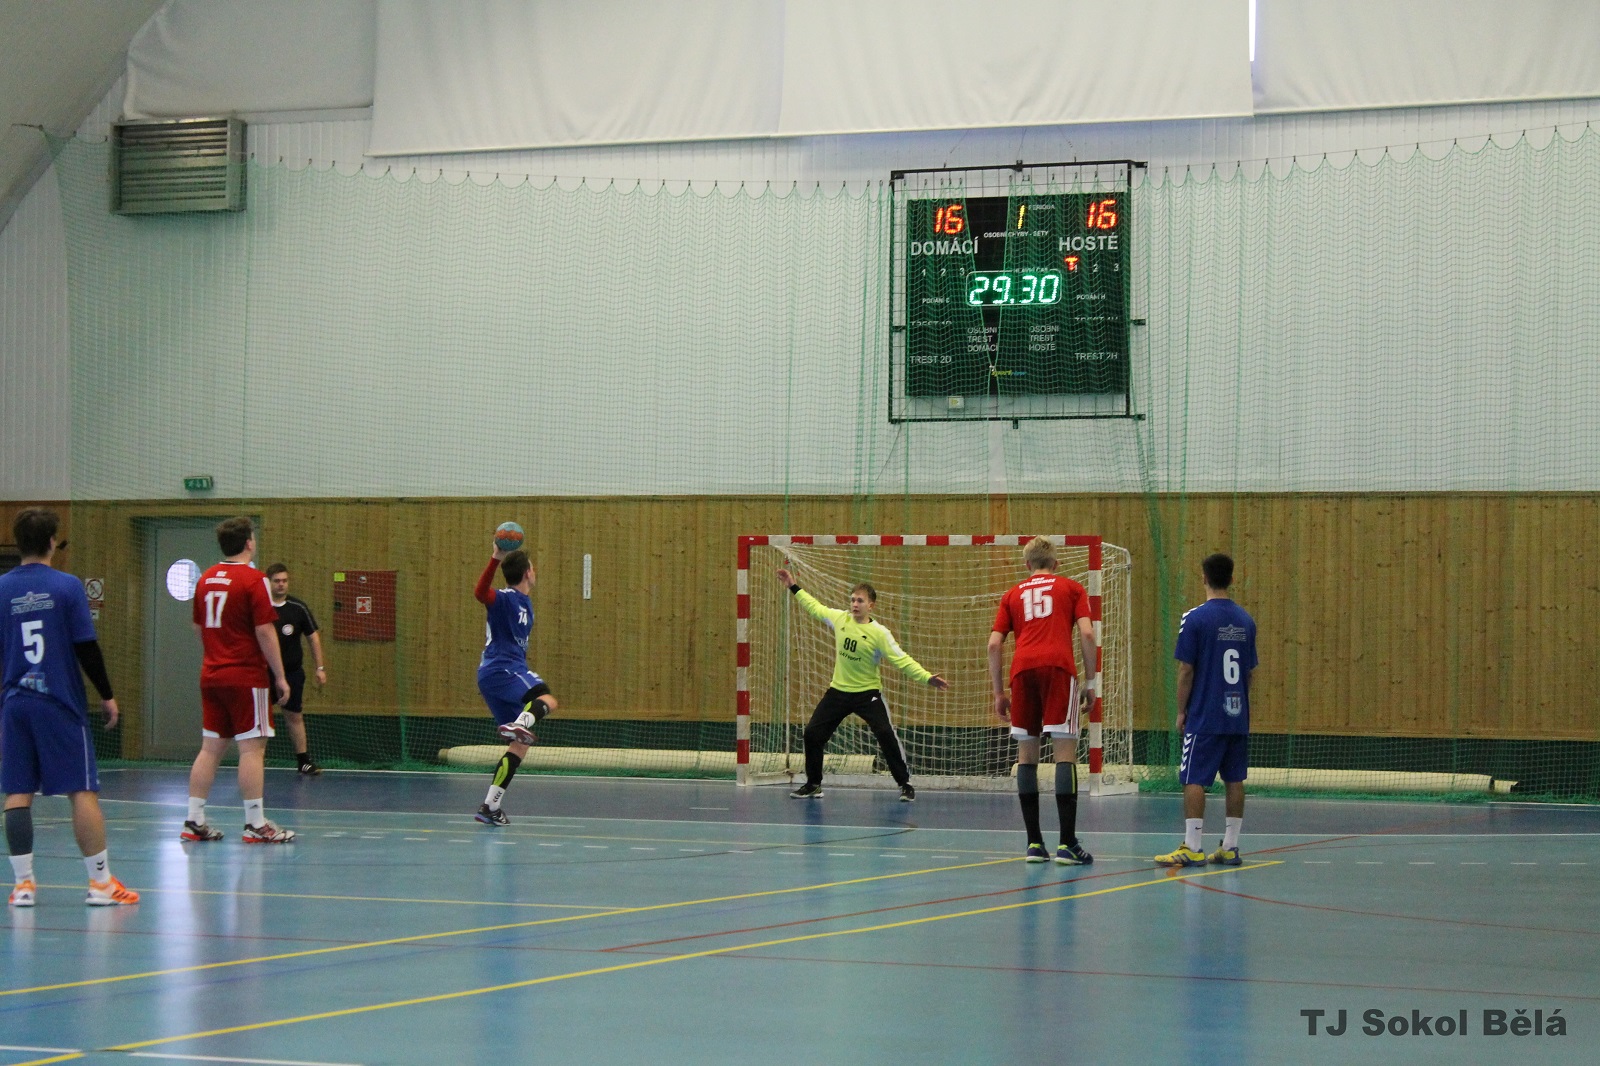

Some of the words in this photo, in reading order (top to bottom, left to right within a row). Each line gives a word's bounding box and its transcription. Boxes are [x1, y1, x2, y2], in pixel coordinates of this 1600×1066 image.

[934, 204, 964, 234] 16
[1017, 204, 1026, 230] 1
[1086, 199, 1117, 229] 16
[910, 236, 979, 256] DOMÁCÍ
[1058, 232, 1119, 252] HOSTÉ
[969, 275, 1060, 305] 29.30
[967, 335, 993, 343] TREST
[1029, 334, 1055, 342] TREST
[910, 355, 939, 364] TREST
[940, 355, 952, 364] 2D
[1074, 352, 1104, 360] TREST
[204, 590, 228, 629] 17
[1020, 585, 1053, 622] 15
[518, 611, 528, 626] 14
[21, 620, 44, 665] 5
[1223, 648, 1240, 685] 6
